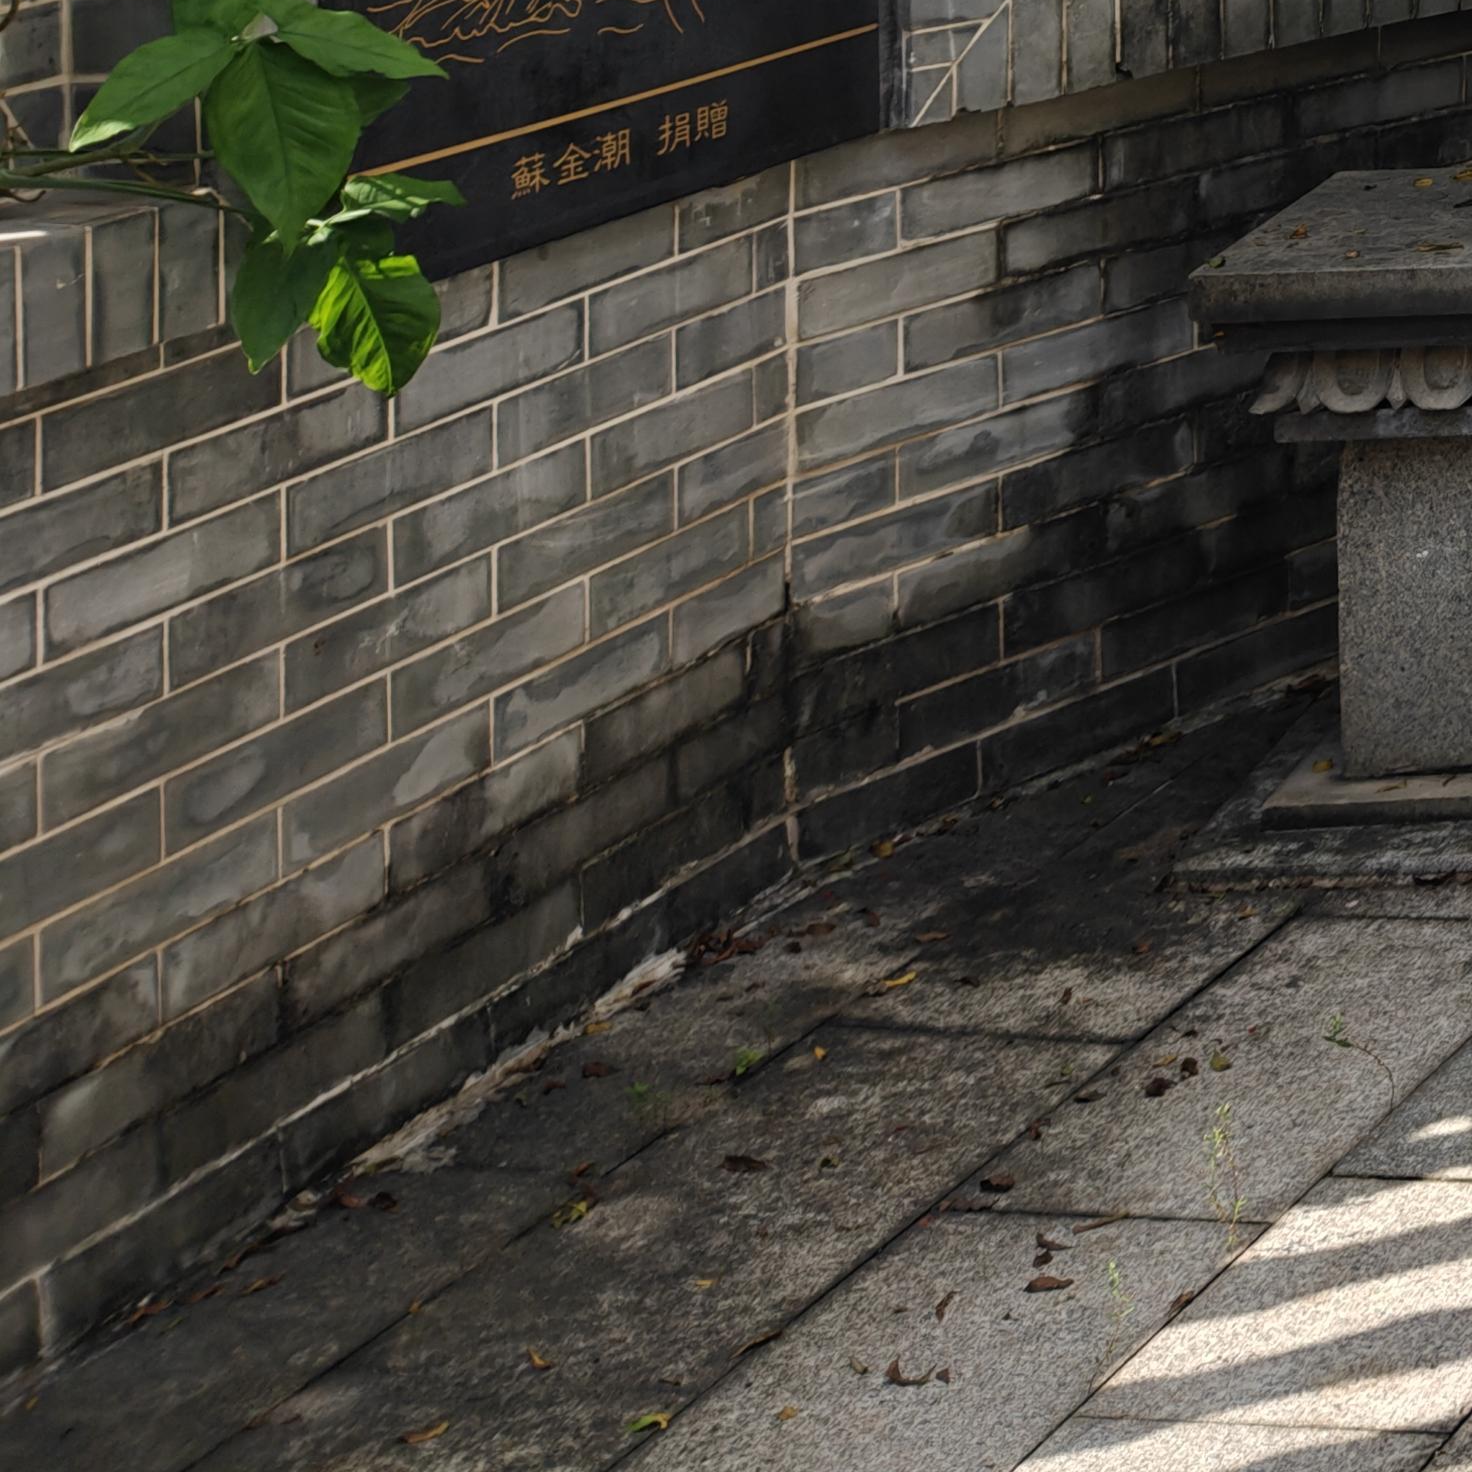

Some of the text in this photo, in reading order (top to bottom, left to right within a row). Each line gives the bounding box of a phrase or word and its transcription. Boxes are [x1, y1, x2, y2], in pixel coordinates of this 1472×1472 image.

[511, 99, 729, 200] 蘇金潮 捐贈
